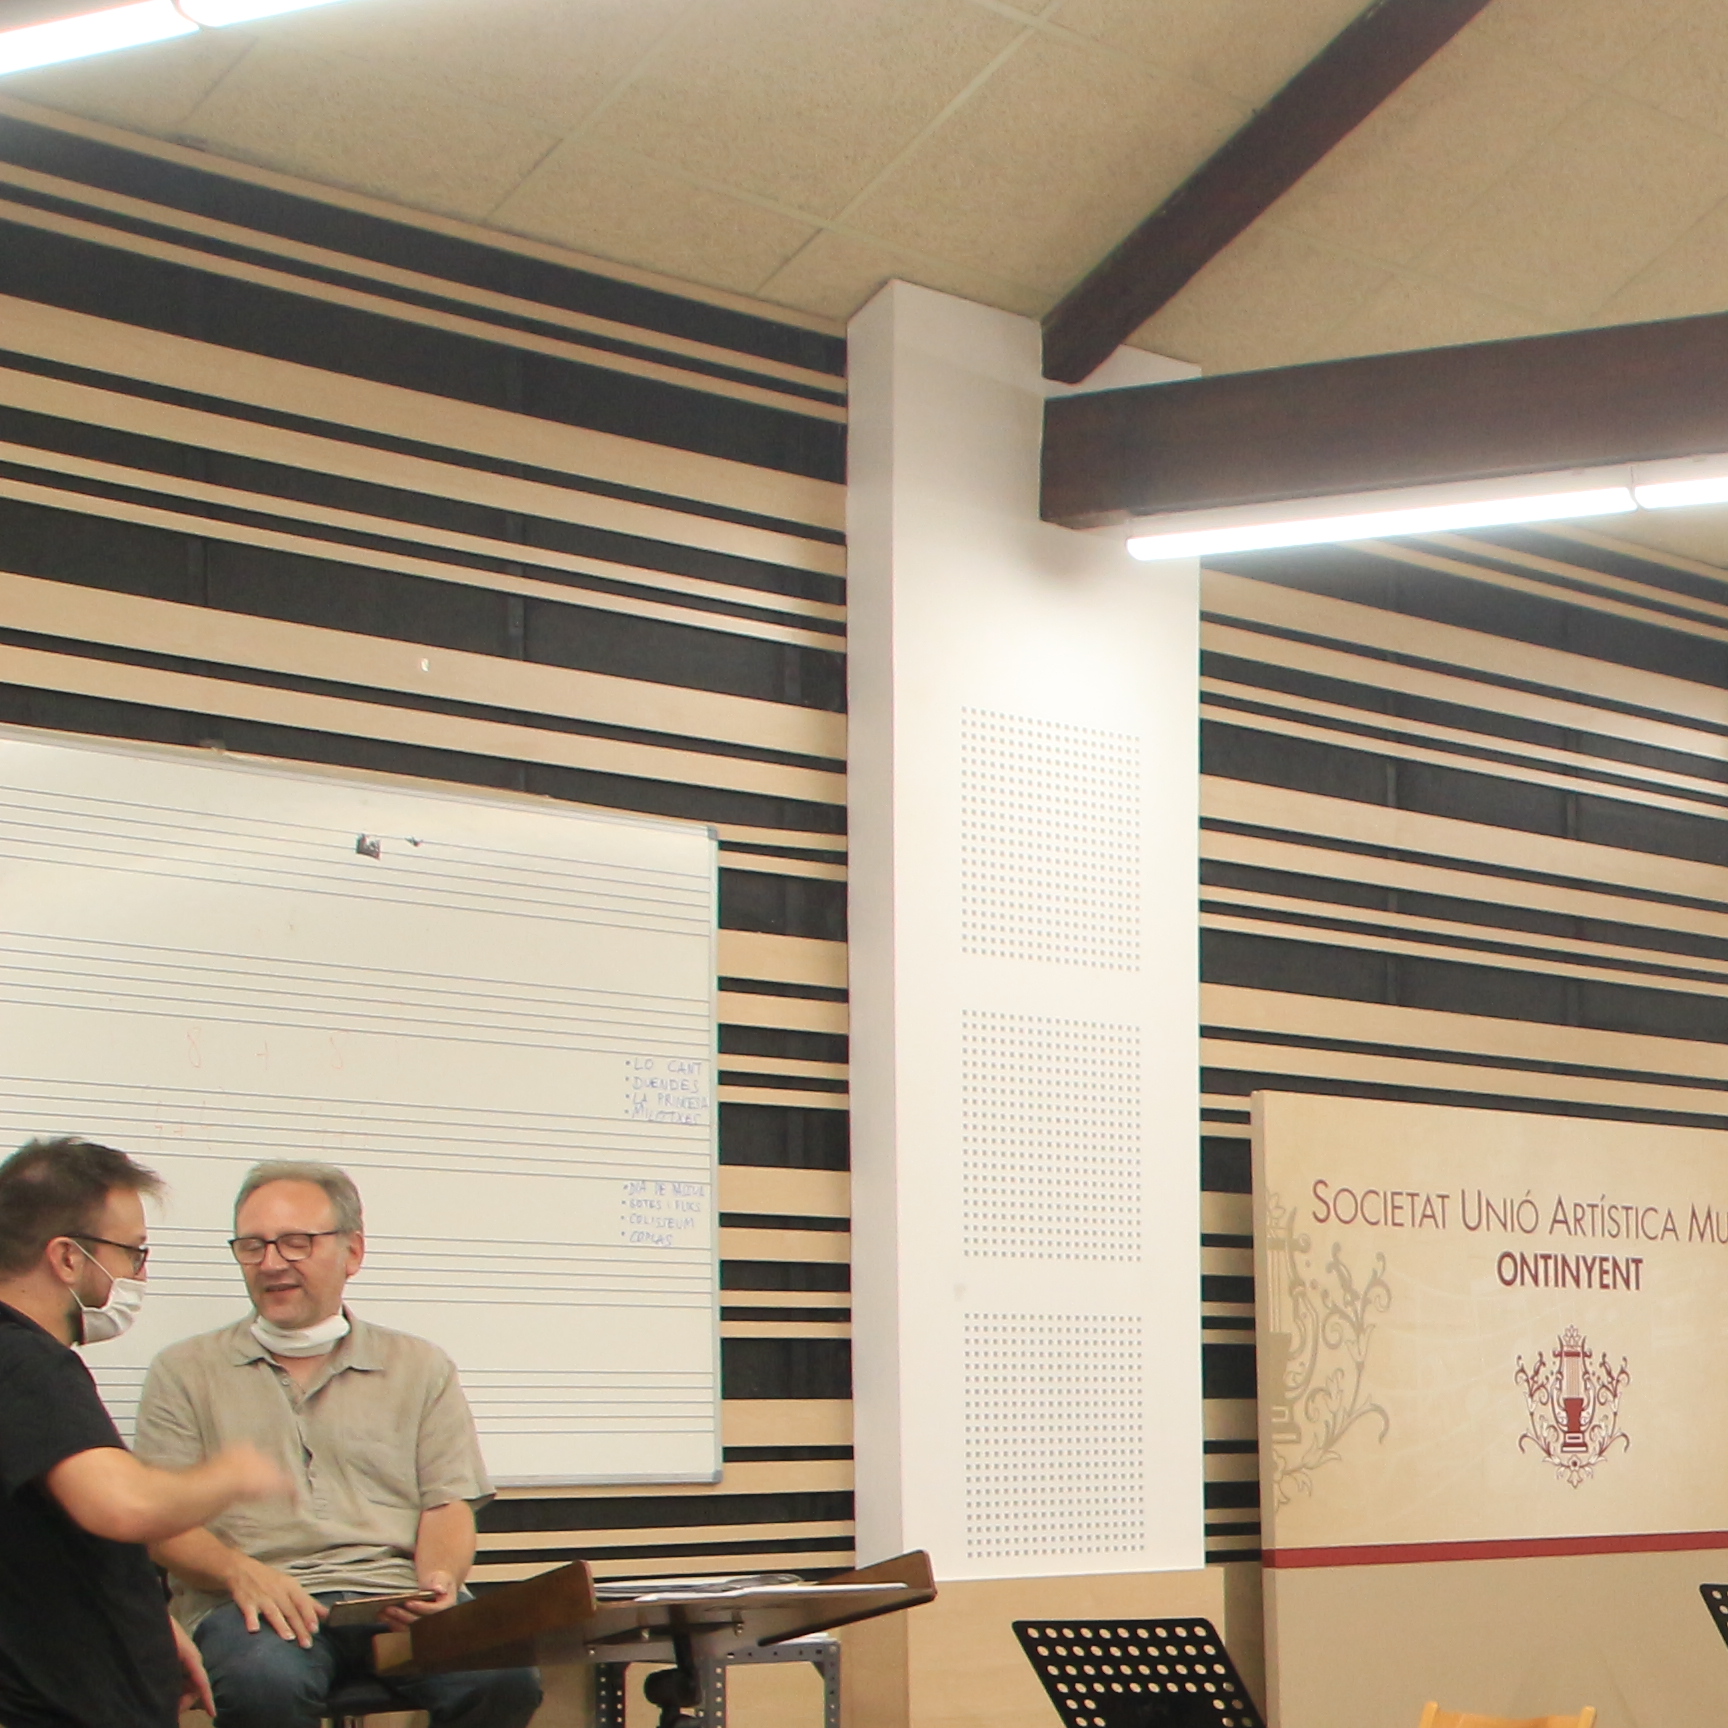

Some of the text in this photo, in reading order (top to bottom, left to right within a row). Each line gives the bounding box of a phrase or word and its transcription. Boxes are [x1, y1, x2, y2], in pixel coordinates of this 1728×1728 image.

[1312, 1178, 1451, 1230] SOCIETAT
[1461, 1188, 1540, 1234] UNIÓ
[1548, 1193, 1681, 1242] ARTÍSTICA
[1496, 1250, 1645, 1291] ONTINYENT
